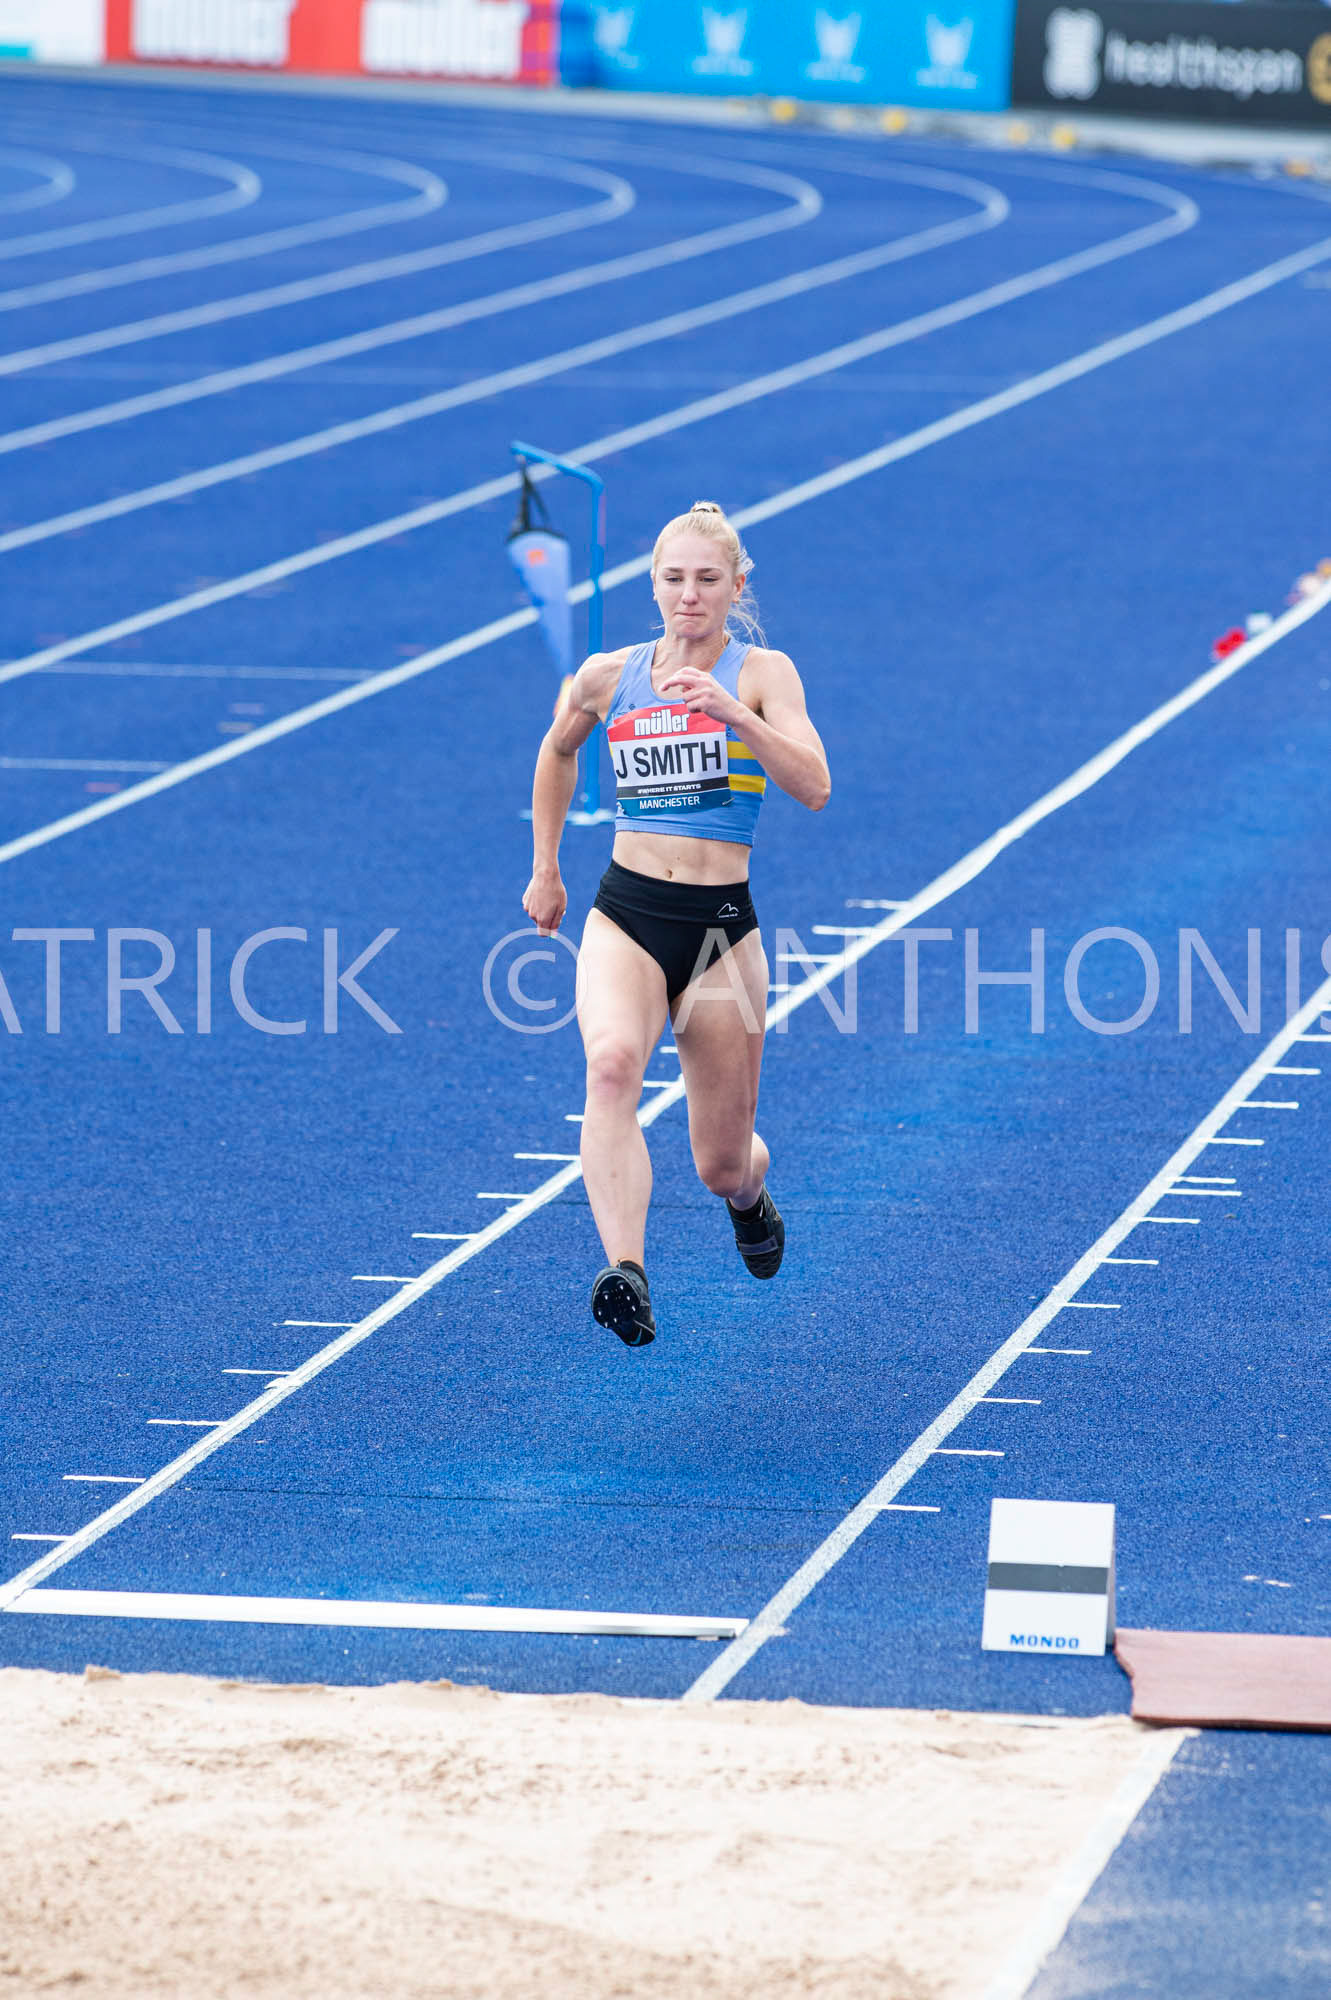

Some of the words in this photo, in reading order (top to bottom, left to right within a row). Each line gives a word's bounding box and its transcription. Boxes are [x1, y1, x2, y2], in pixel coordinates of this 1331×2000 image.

[634, 709, 690, 736] müller
[615, 750, 628, 779] J
[633, 740, 722, 777] SMITH
[673, 784, 702, 792] STARTS
[640, 796, 700, 810] MANCHESTER
[1010, 1634, 1080, 1649] MONDO
